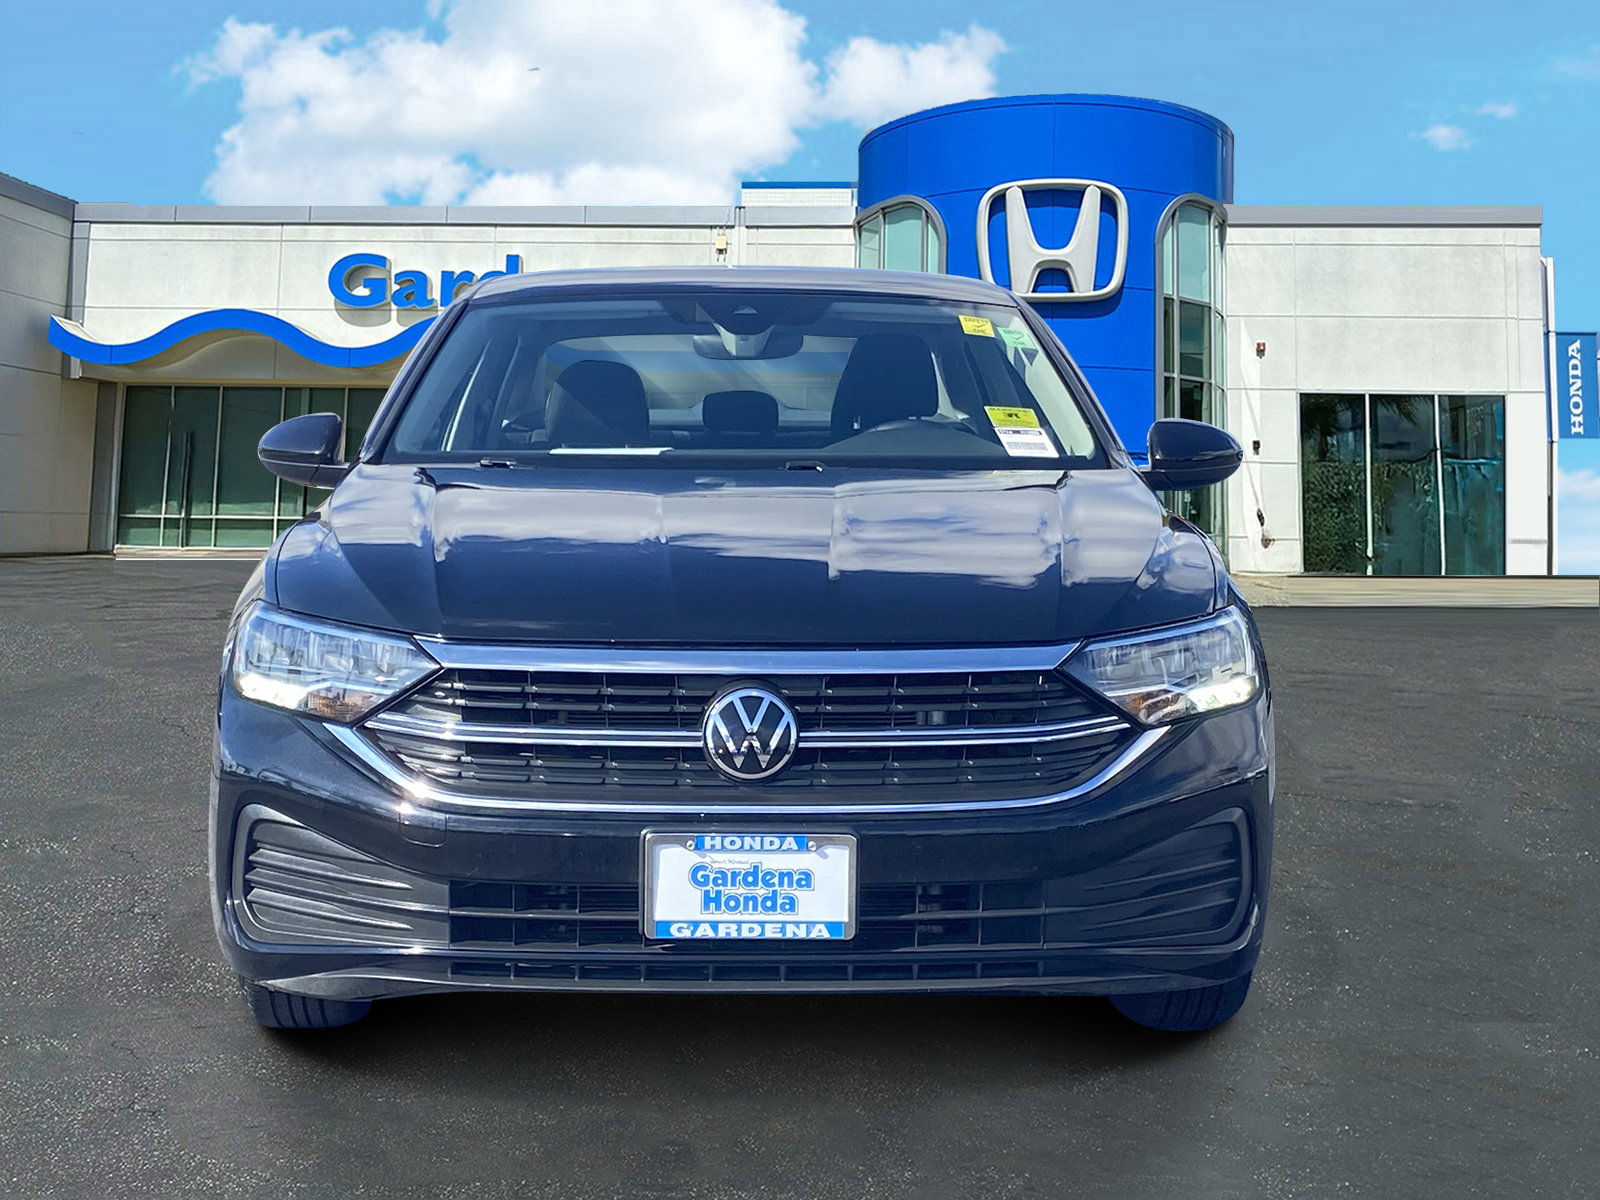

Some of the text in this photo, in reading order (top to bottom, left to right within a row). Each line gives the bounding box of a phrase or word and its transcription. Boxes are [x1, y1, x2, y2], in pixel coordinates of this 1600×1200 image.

[1006, 185, 1101, 294] H
[1568, 339, 1584, 435] HONDA
[712, 694, 790, 769] VW
[704, 836, 799, 850] HONDA
[689, 863, 814, 889] Gardena
[702, 889, 797, 913] Honda
[669, 923, 831, 938] GARDENA
